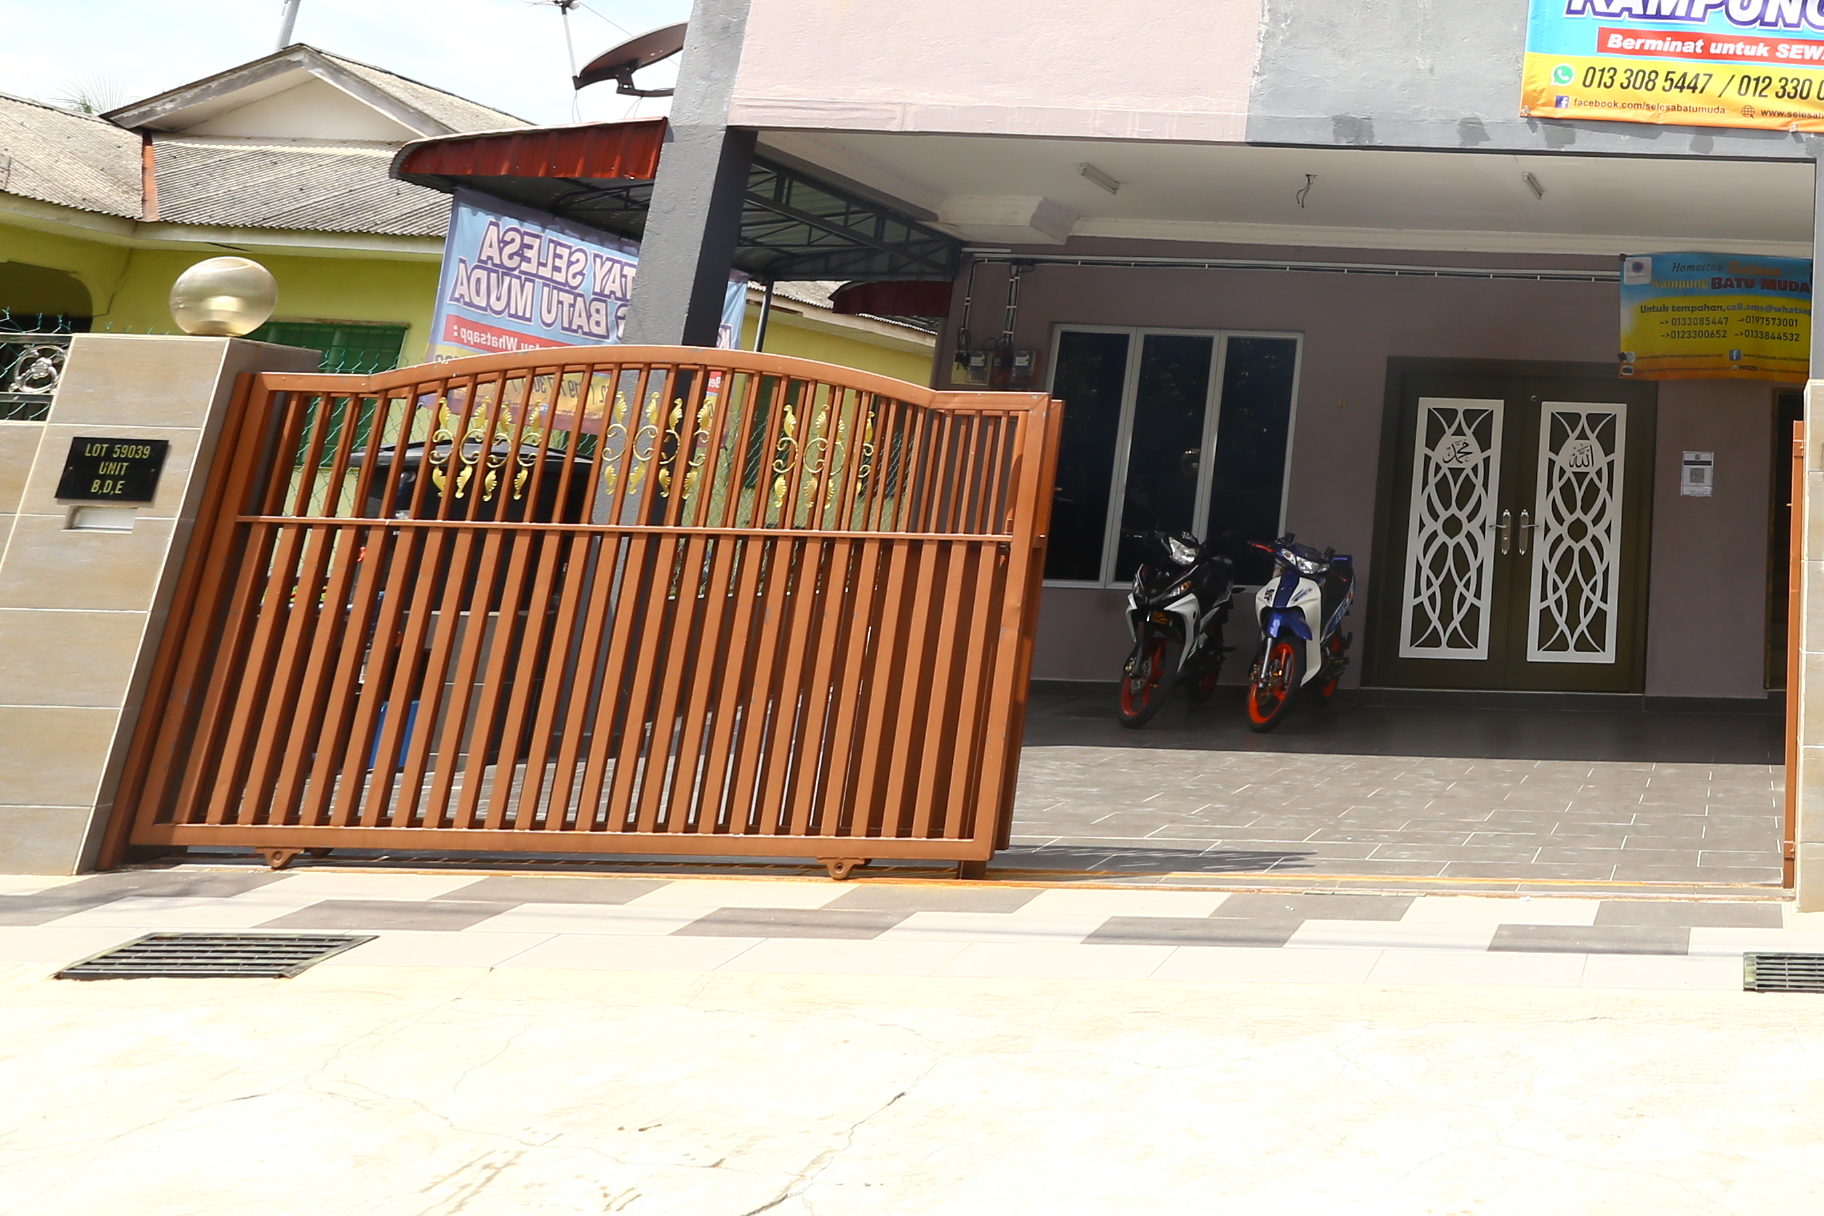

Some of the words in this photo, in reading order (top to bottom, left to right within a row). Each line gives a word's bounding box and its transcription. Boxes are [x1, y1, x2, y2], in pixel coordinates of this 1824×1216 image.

[1607, 33, 1705, 54] Berminat
[1709, 40, 1770, 57] untuk
[1582, 66, 1617, 89] 013
[1620, 68, 1659, 92] 308
[1662, 70, 1713, 95] 5447
[1737, 74, 1772, 98] 012
[1775, 76, 1813, 100] 330
[1574, 98, 1726, 115] facebook.com/selesabatumuda
[1671, 262, 1724, 274] Homestay
[1652, 278, 1709, 291] Kampung
[1710, 277, 1756, 290] BATU
[1760, 278, 1811, 293] MUDA
[1641, 304, 1669, 313] Untuk
[1671, 304, 1726, 314] tempahan,
[85, 443, 109, 457] LOT
[112, 444, 151, 459] 59039
[98, 461, 129, 476] UNIT
